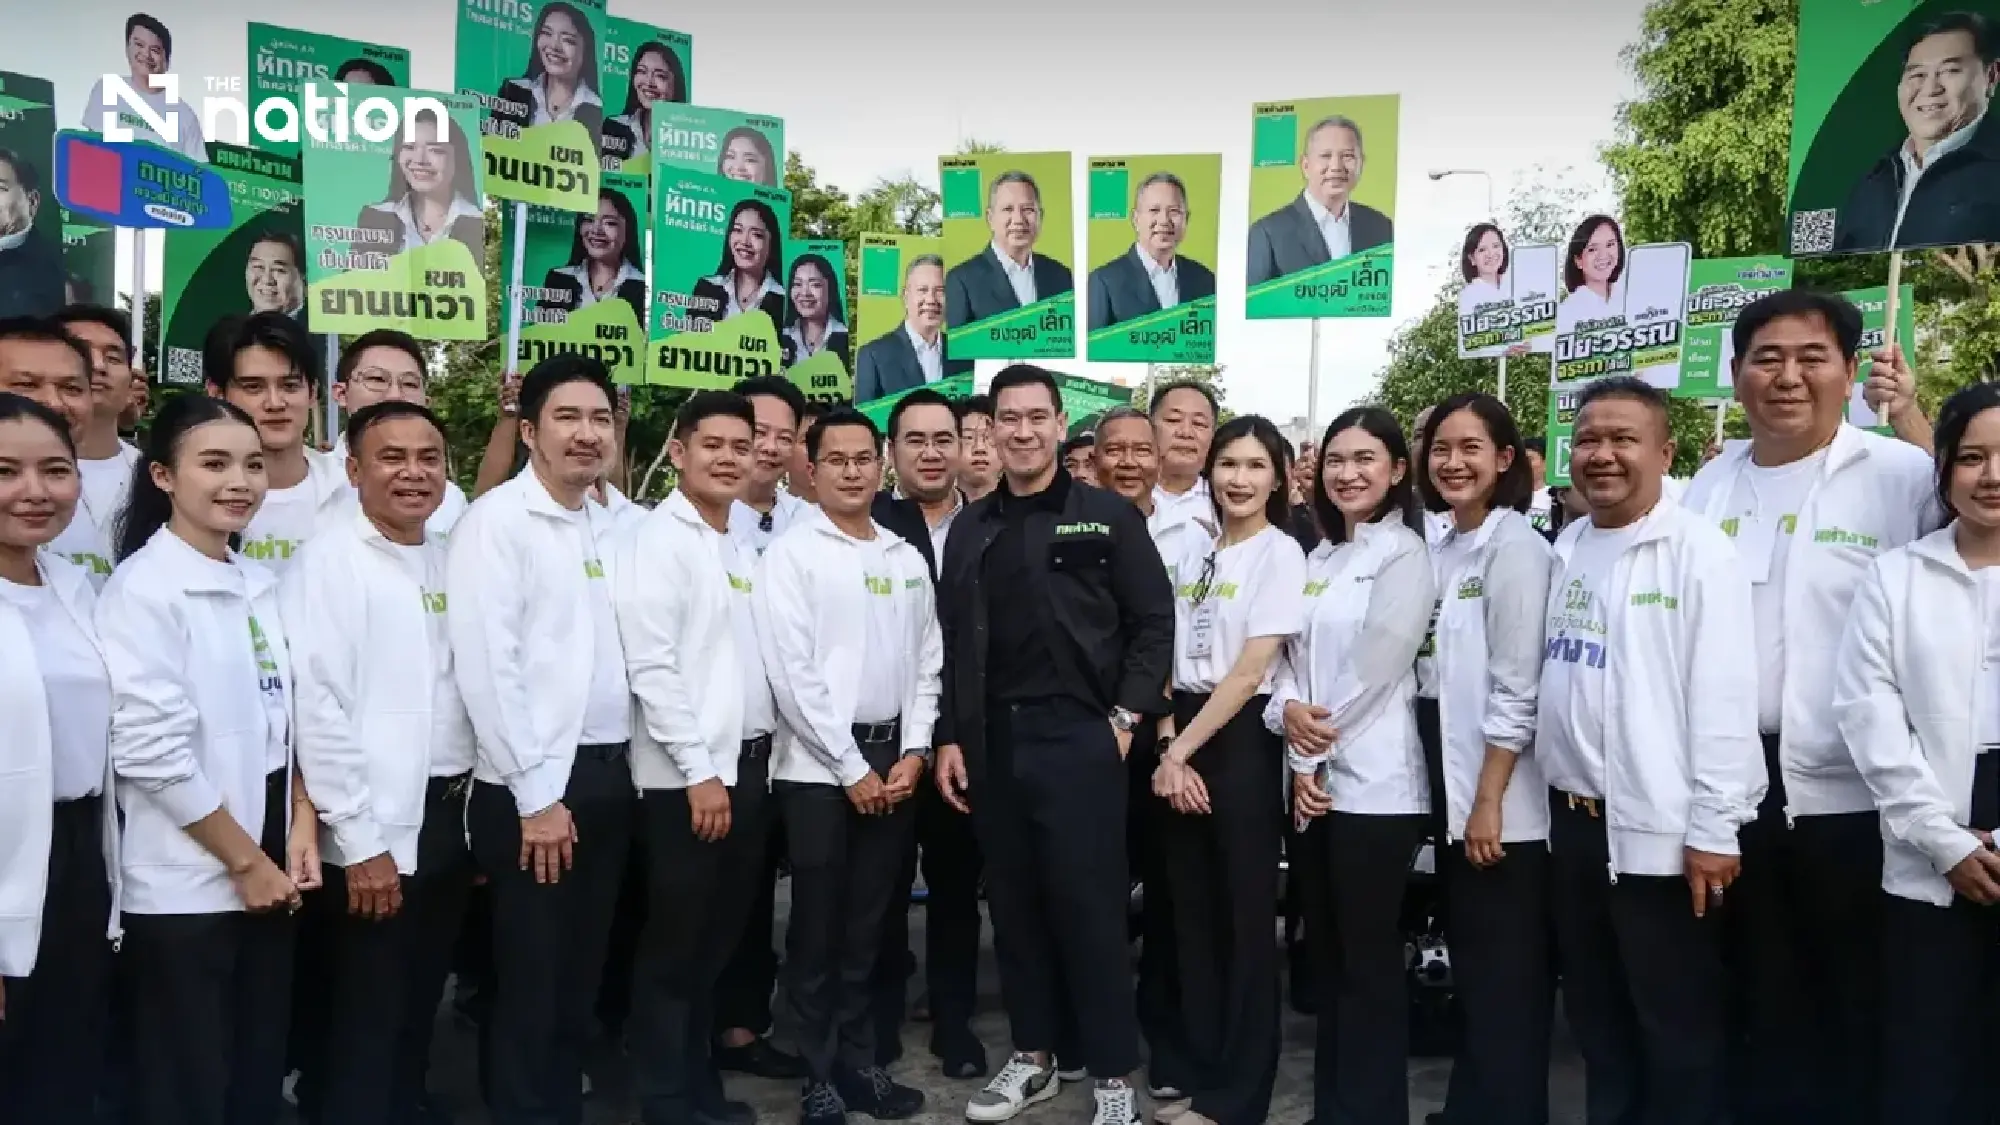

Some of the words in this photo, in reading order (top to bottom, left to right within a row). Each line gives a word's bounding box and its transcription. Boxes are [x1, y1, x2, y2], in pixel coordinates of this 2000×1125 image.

[550, 146, 584, 166] เขต
[484, 150, 590, 195] านนาวา
[414, 270, 467, 289] เขต
[1351, 261, 1389, 288] เล็ก
[321, 288, 476, 321] ยานนาวา
[1040, 307, 1073, 332] เล็ก
[1180, 311, 1213, 336] เล็ก
[595, 324, 629, 341] เขต
[739, 334, 768, 353] เขต
[1556, 319, 1680, 362] ปิยะวรรณ
[658, 344, 773, 378] ยานนาวา
[811, 373, 838, 389] เขต
